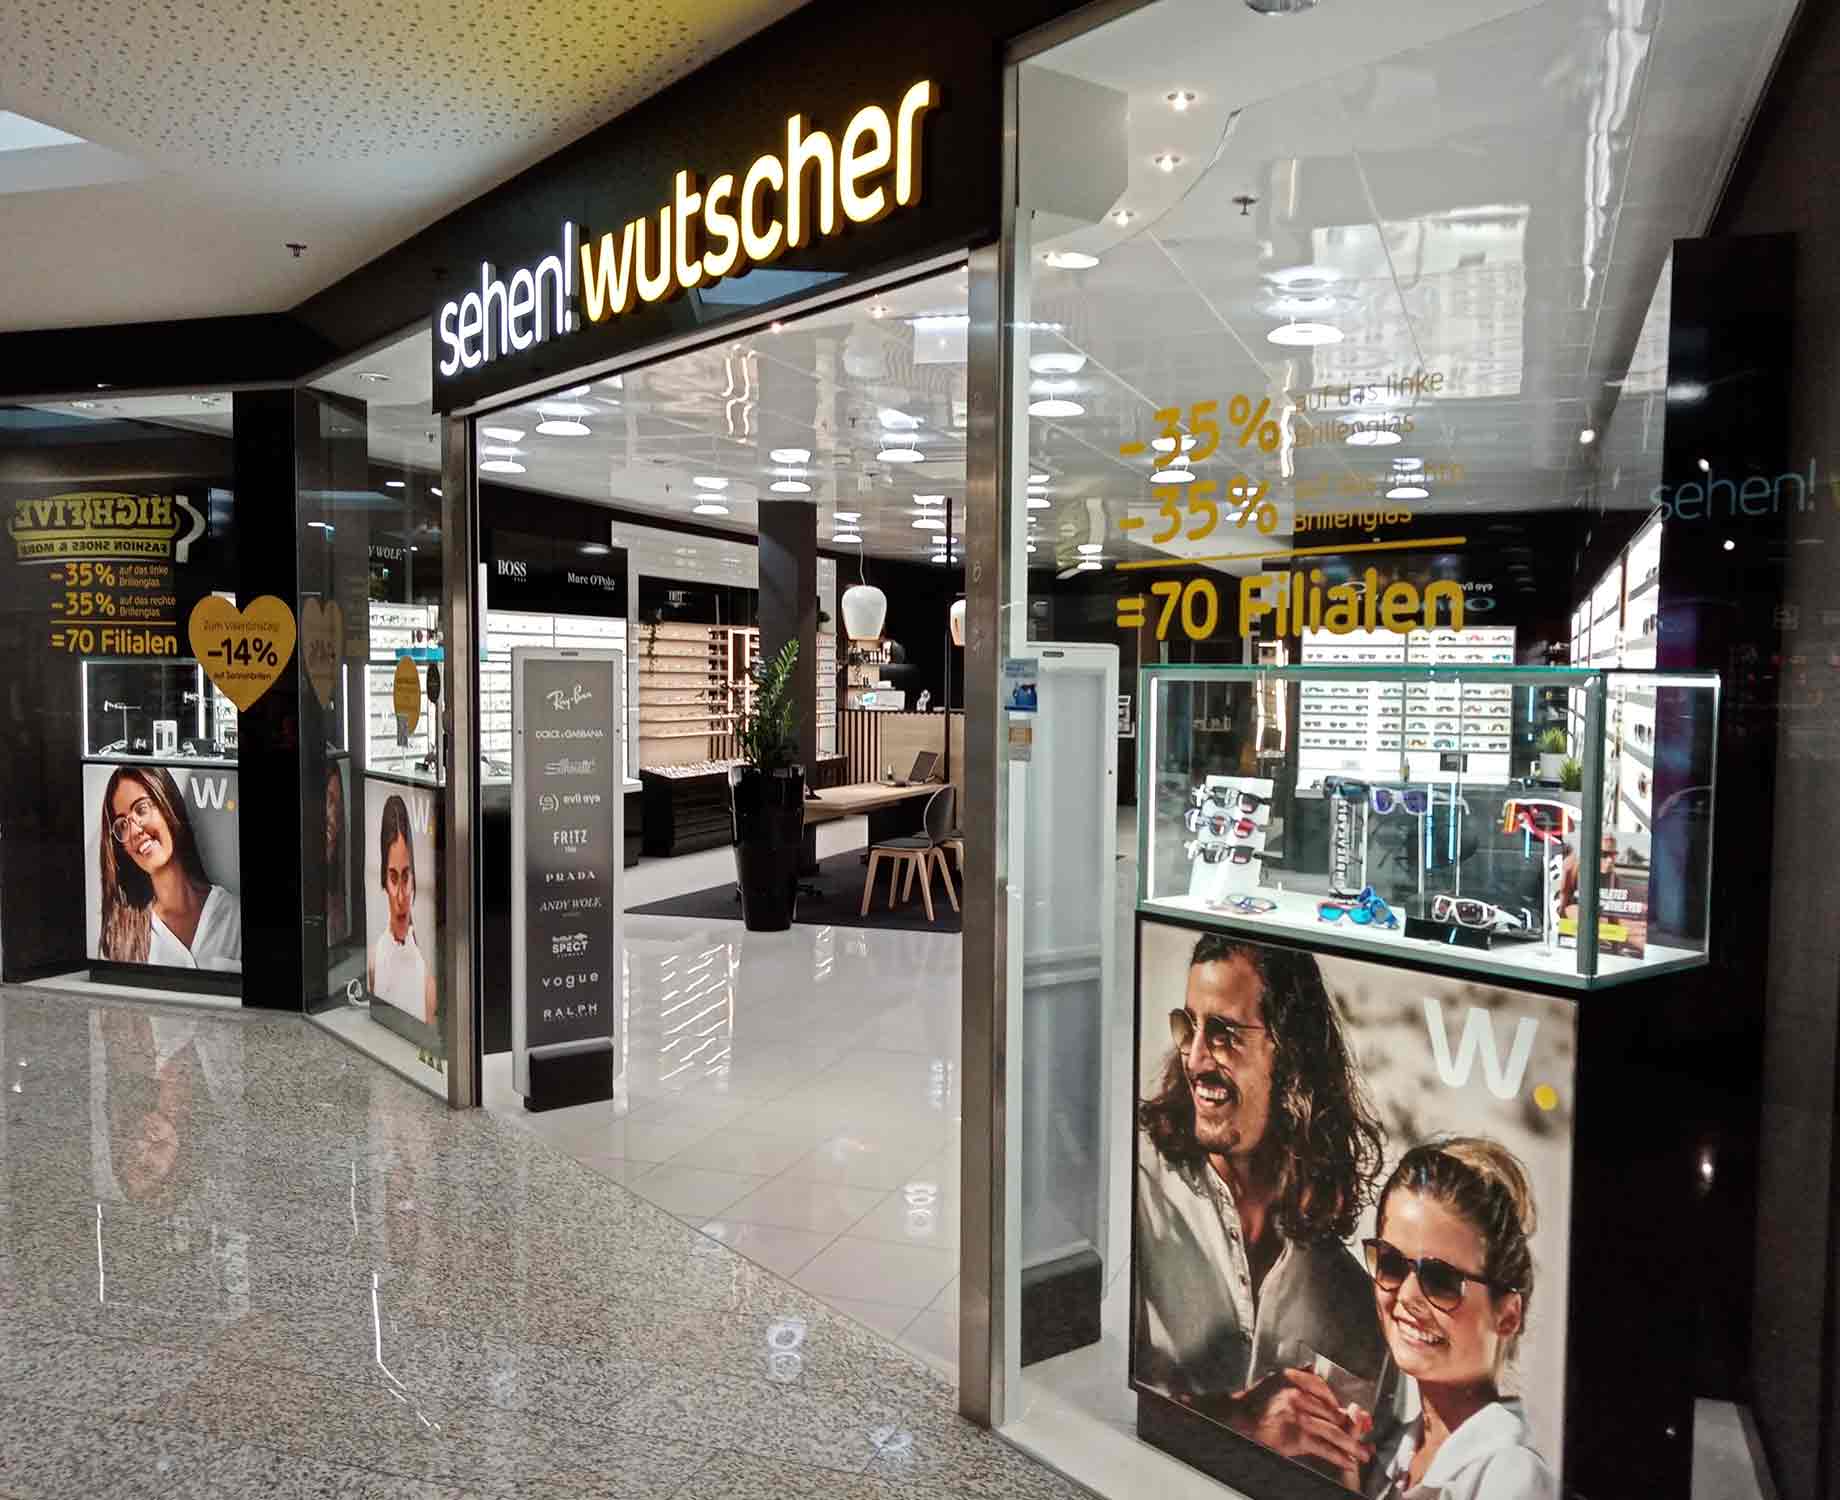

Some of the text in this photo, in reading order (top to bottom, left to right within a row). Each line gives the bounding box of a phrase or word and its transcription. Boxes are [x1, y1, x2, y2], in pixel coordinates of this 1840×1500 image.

[439, 79, 931, 377] sehen! wutscher
[1119, 393, 1282, 469] -35%
[1387, 368, 1443, 397] linke
[1650, 456, 1817, 521] sehen!
[1118, 474, 1280, 545] -35%
[51, 563, 115, 587] -35%
[497, 560, 527, 577] BOSS
[567, 572, 589, 586] Marc
[51, 592, 116, 617] -35%
[1116, 565, 1464, 641] =70 Filialen
[51, 629, 178, 656] =70 Filialen
[207, 638, 278, 667] -14%
[553, 830, 588, 847] FRITZ
[545, 871, 596, 882] PRADA
[552, 941, 588, 954] SPECT
[542, 972, 599, 989] vogue
[544, 1004, 598, 1021] RALPH
